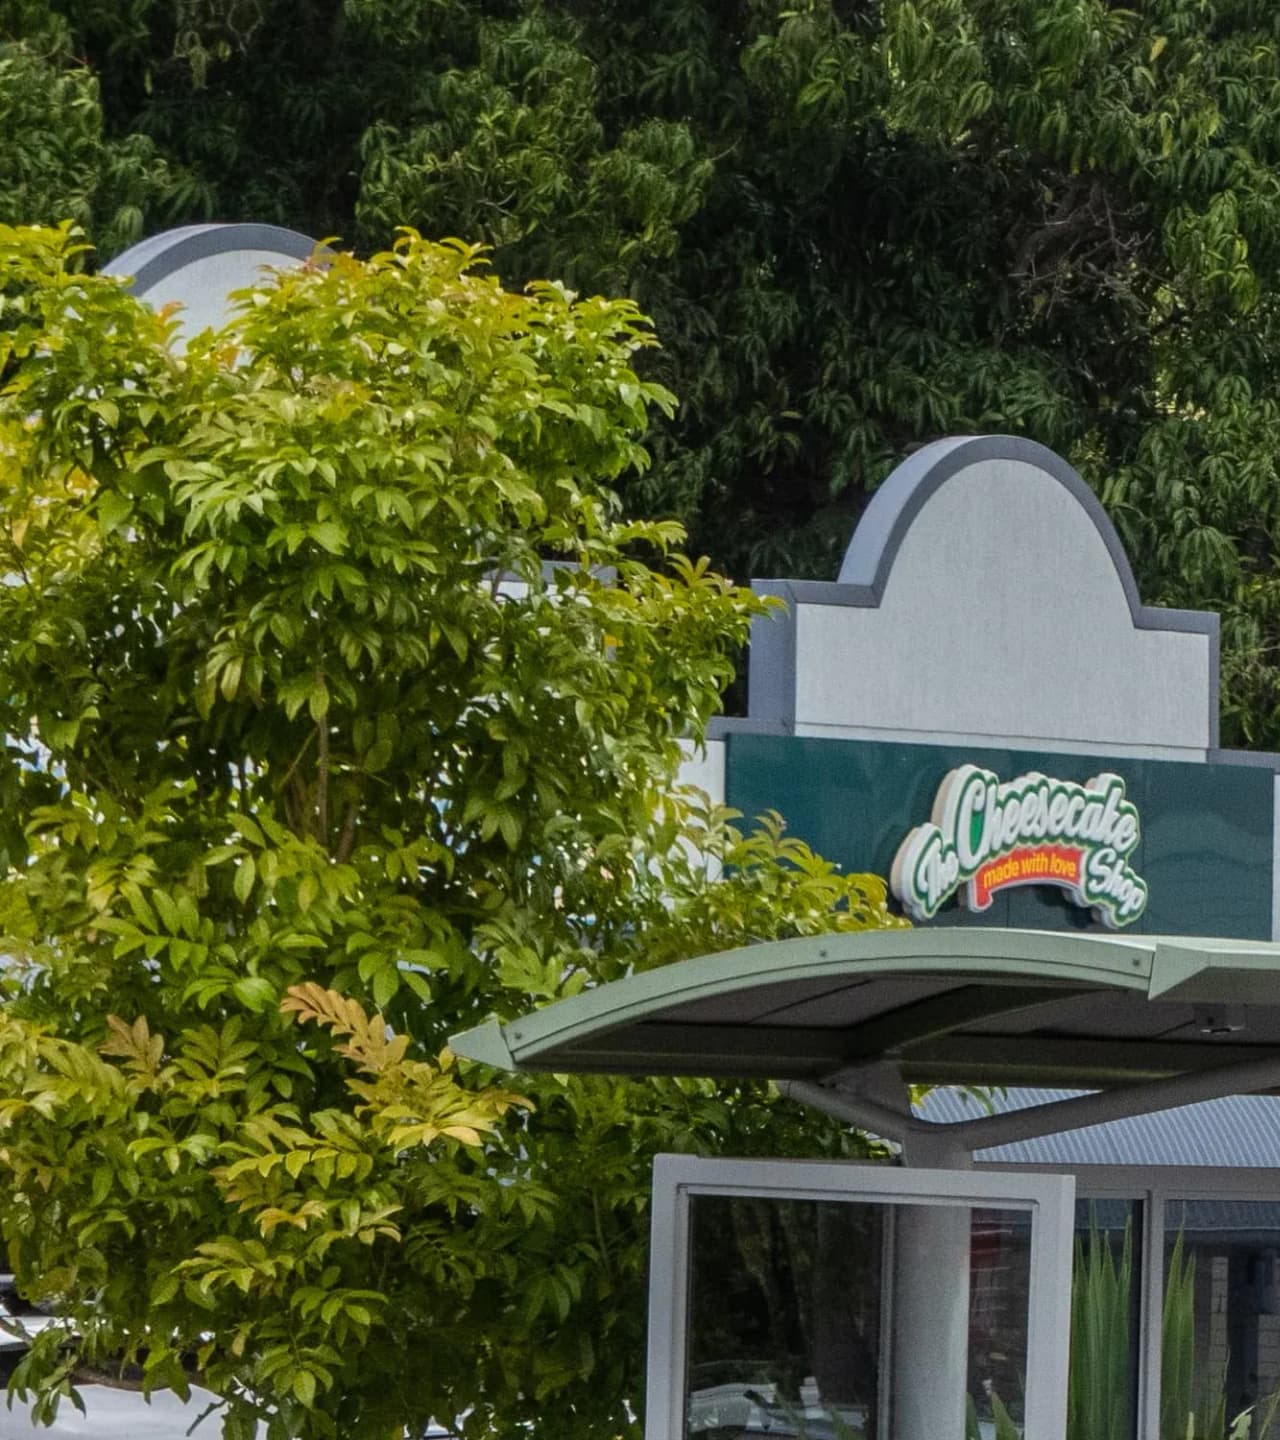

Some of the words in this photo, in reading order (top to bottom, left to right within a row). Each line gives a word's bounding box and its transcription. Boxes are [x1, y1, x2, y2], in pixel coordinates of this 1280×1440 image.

[957, 778, 1137, 870] Cheesecake
[917, 838, 959, 906] The
[983, 859, 1020, 889] made
[1021, 854, 1048, 877] with
[1050, 852, 1076, 878] love
[1088, 848, 1146, 916] Shop
